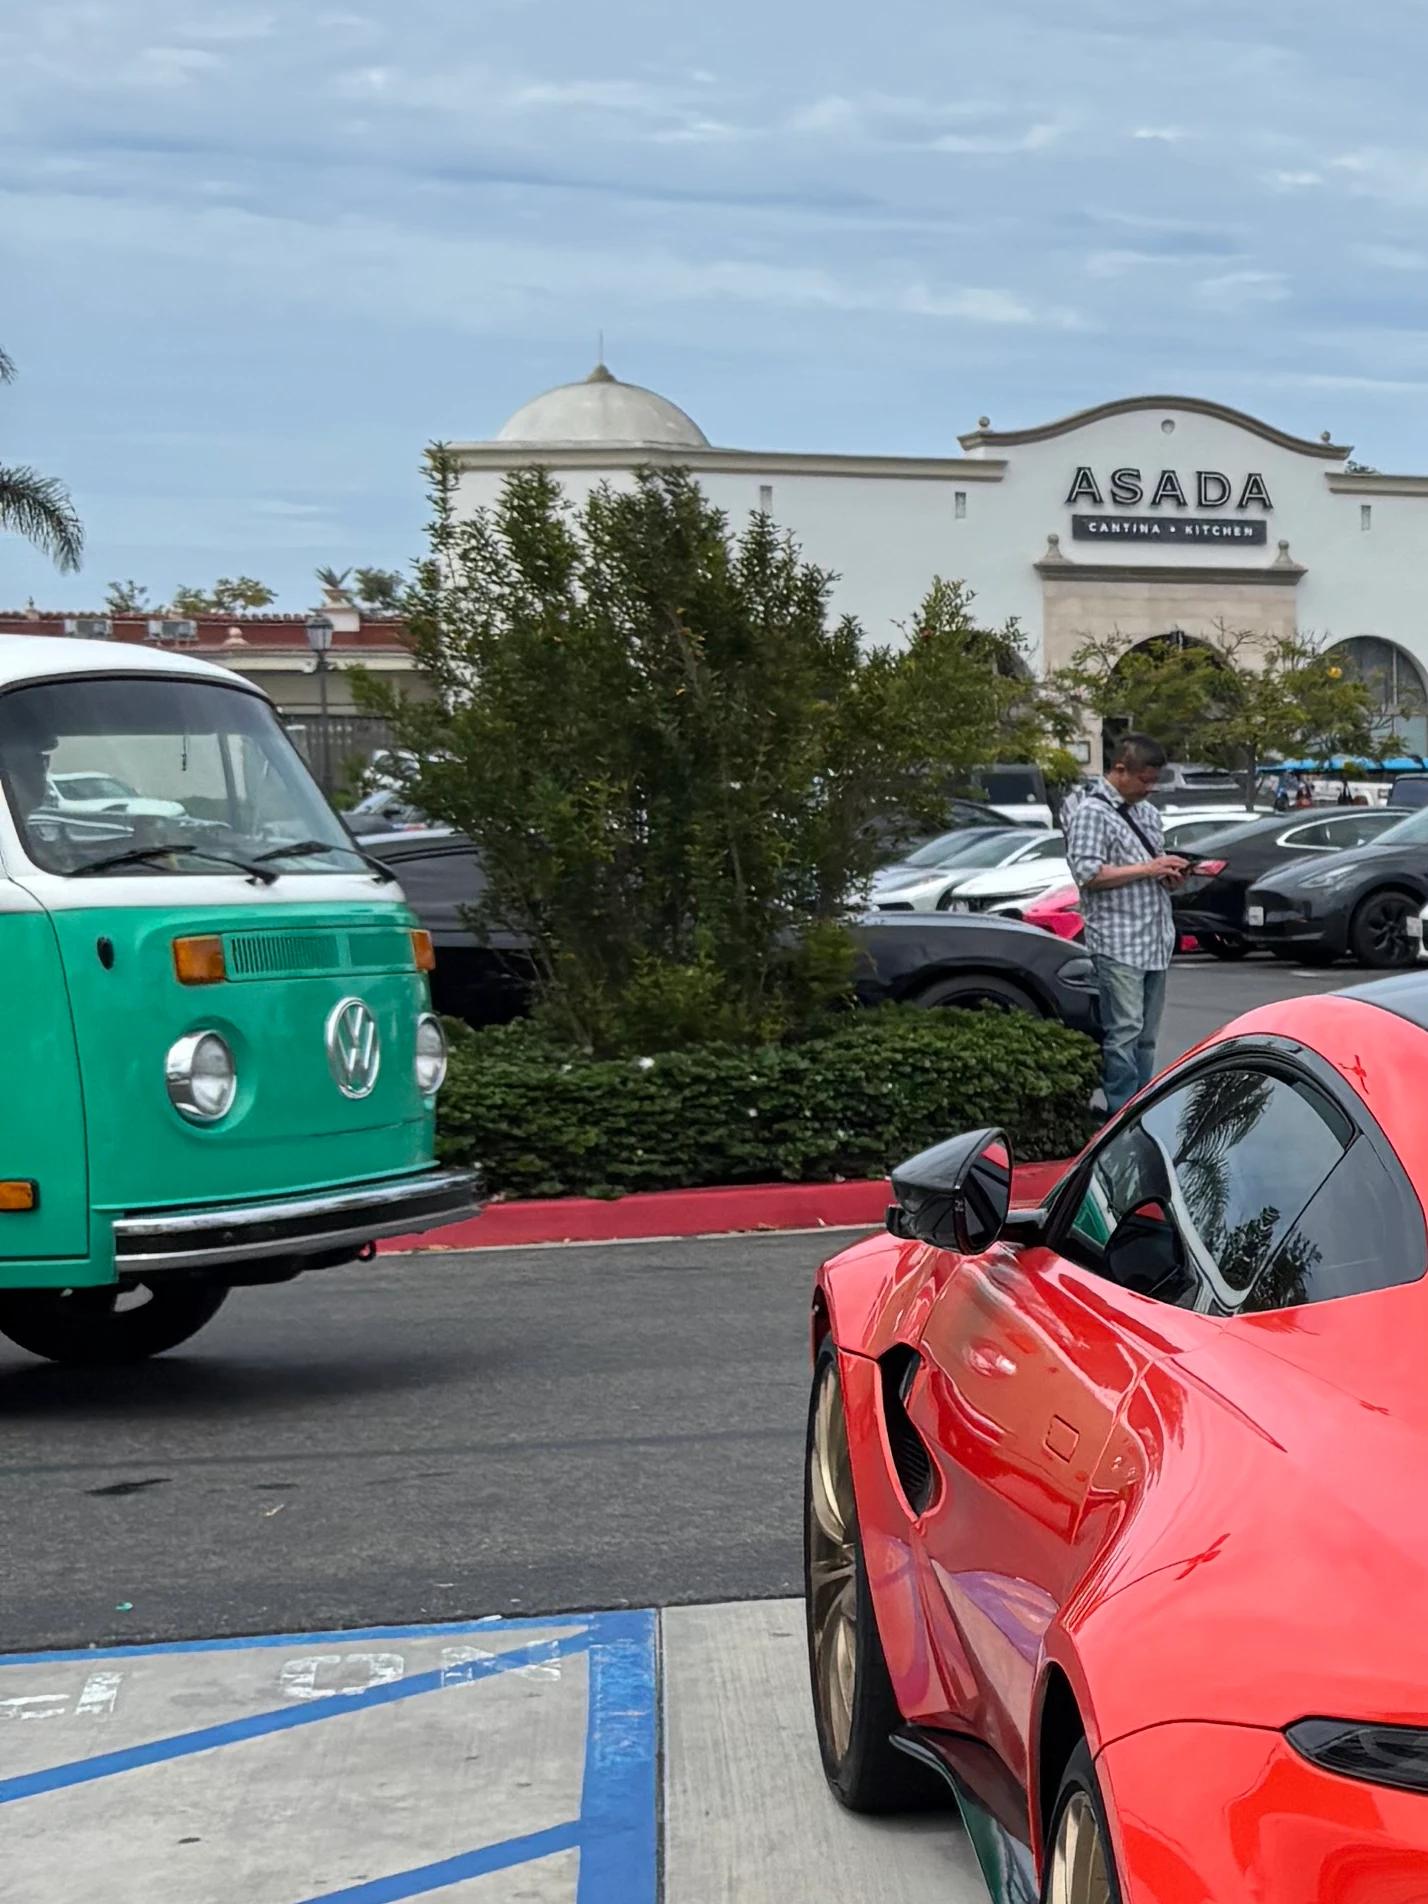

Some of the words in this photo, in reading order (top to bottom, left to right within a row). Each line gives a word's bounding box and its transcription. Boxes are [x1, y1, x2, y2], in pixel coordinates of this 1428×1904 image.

[1065, 466, 1274, 510] ASADA
[1088, 521, 1161, 535] CANTINA
[1184, 524, 1254, 537] KITCHEN
